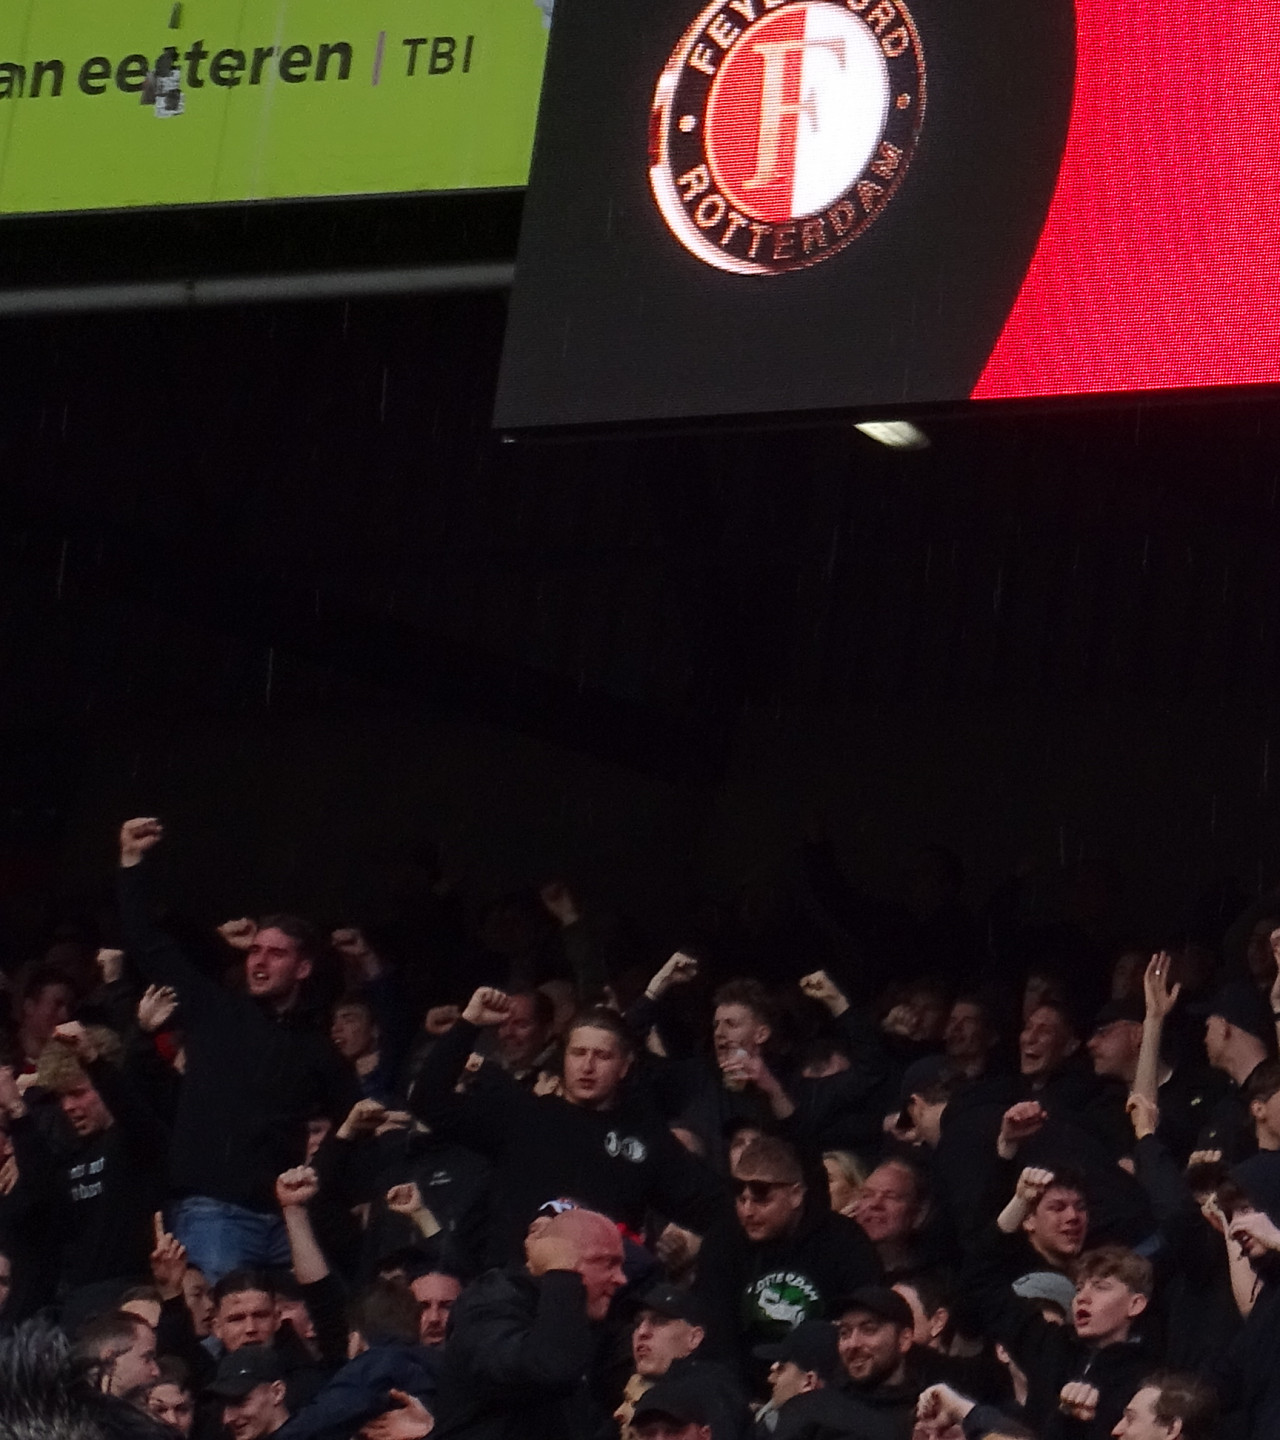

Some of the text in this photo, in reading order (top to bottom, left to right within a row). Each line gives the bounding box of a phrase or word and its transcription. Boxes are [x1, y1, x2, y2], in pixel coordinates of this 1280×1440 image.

[403, 35, 475, 77] TBI
[676, 140, 904, 260] ROTTERDAM
[747, 1271, 819, 1302] OTTERDAM
